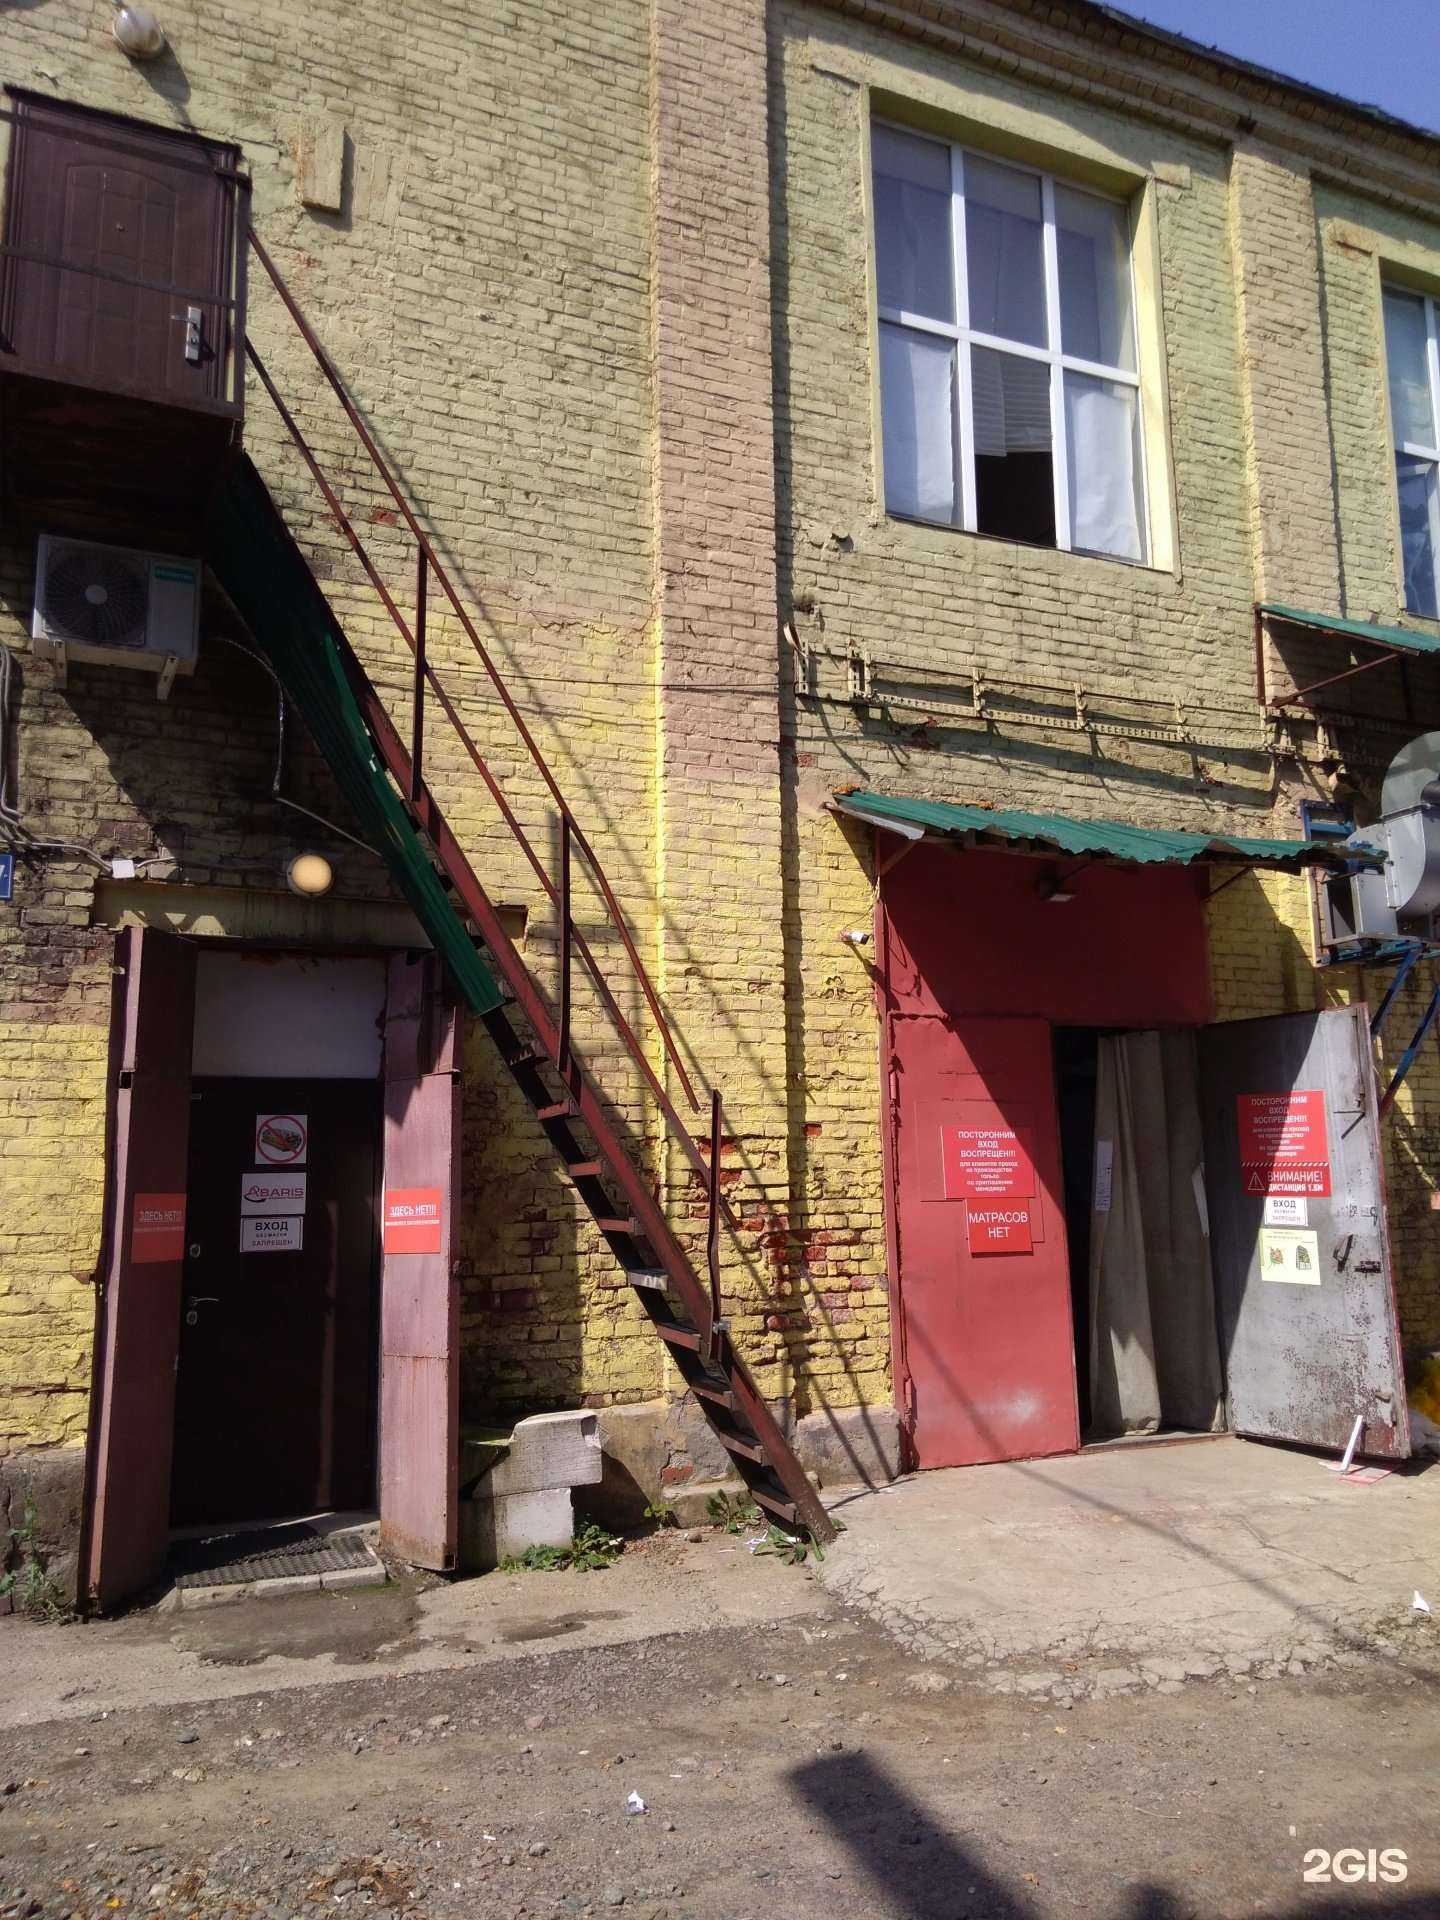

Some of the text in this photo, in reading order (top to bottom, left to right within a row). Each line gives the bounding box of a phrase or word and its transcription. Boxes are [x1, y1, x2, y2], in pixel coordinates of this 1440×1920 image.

[1251, 1096, 1307, 1105] ПОСТОРОННИМ
[1269, 1106, 1290, 1114] ВХОД
[958, 1131, 1016, 1139] ПОСТОРОННИМ
[977, 1140, 999, 1148] ВХОД
[960, 1150, 1016, 1159] ВОСПРЕЩЕН!!!
[1268, 1171, 1324, 1182] ВНИМАНИЕ!
[248, 1186, 304, 1198] ABARIS
[1268, 1184, 1306, 1192] ДИСТАНЦИЯ
[1273, 1200, 1297, 1209] ВХОД
[390, 1205, 415, 1217] ЗДЕСЬ
[968, 1211, 1028, 1223] МАТРАСОВ
[255, 1221, 289, 1231] ВХОД
[988, 1226, 1010, 1238] НЕТ
[252, 1239, 293, 1247] ЗАПРЕЩЕН
